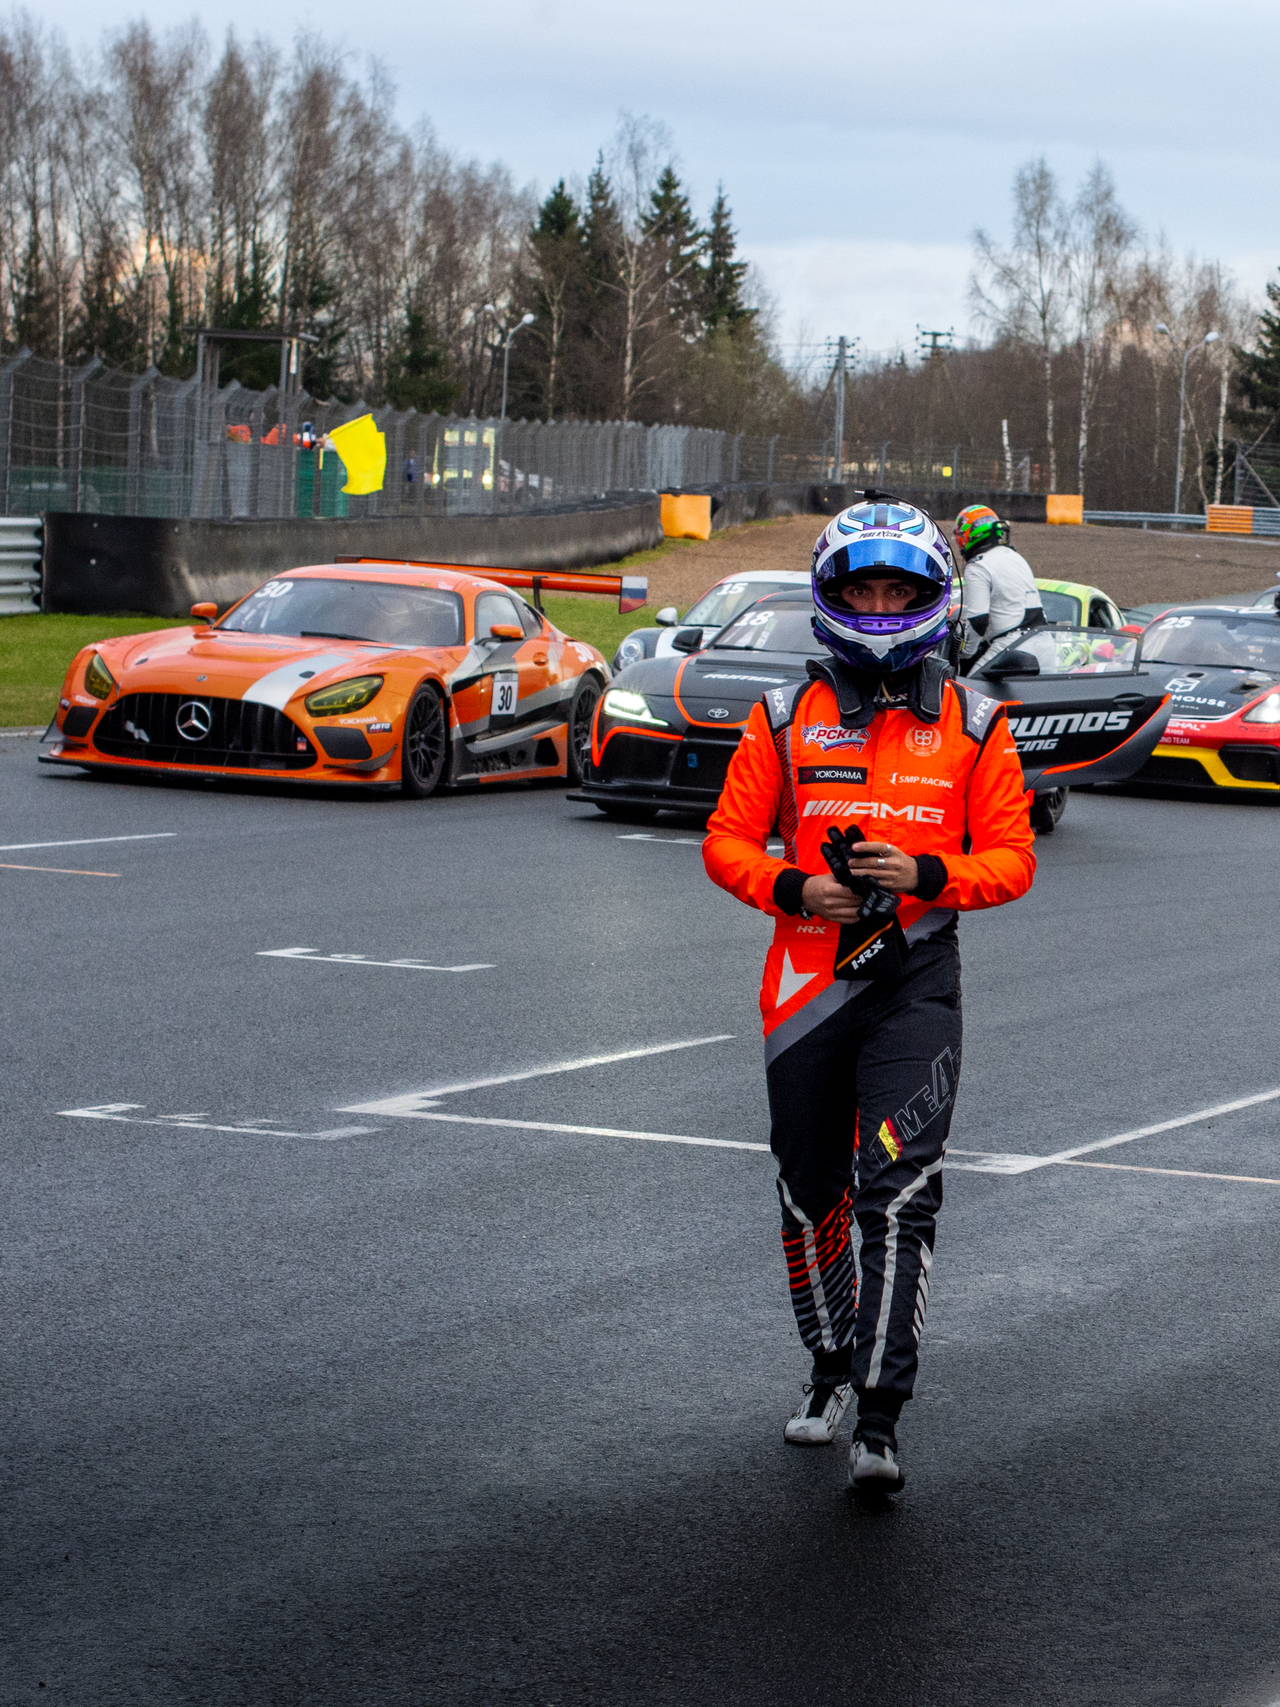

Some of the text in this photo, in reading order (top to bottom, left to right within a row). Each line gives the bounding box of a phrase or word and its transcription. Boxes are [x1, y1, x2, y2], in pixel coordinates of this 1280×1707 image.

[254, 581, 294, 598] 30
[716, 583, 748, 596] 15
[734, 611, 775, 626] 18
[1158, 616, 1195, 631] 25
[566, 641, 595, 663] 30
[497, 685, 513, 711] 30
[1171, 694, 1227, 708] HOUSE
[1015, 738, 1060, 753] CING
[814, 770, 863, 781] YOKOHAMA
[898, 775, 953, 789] SMP RACING
[796, 925, 827, 935] HRX
[851, 938, 885, 971] HRX
